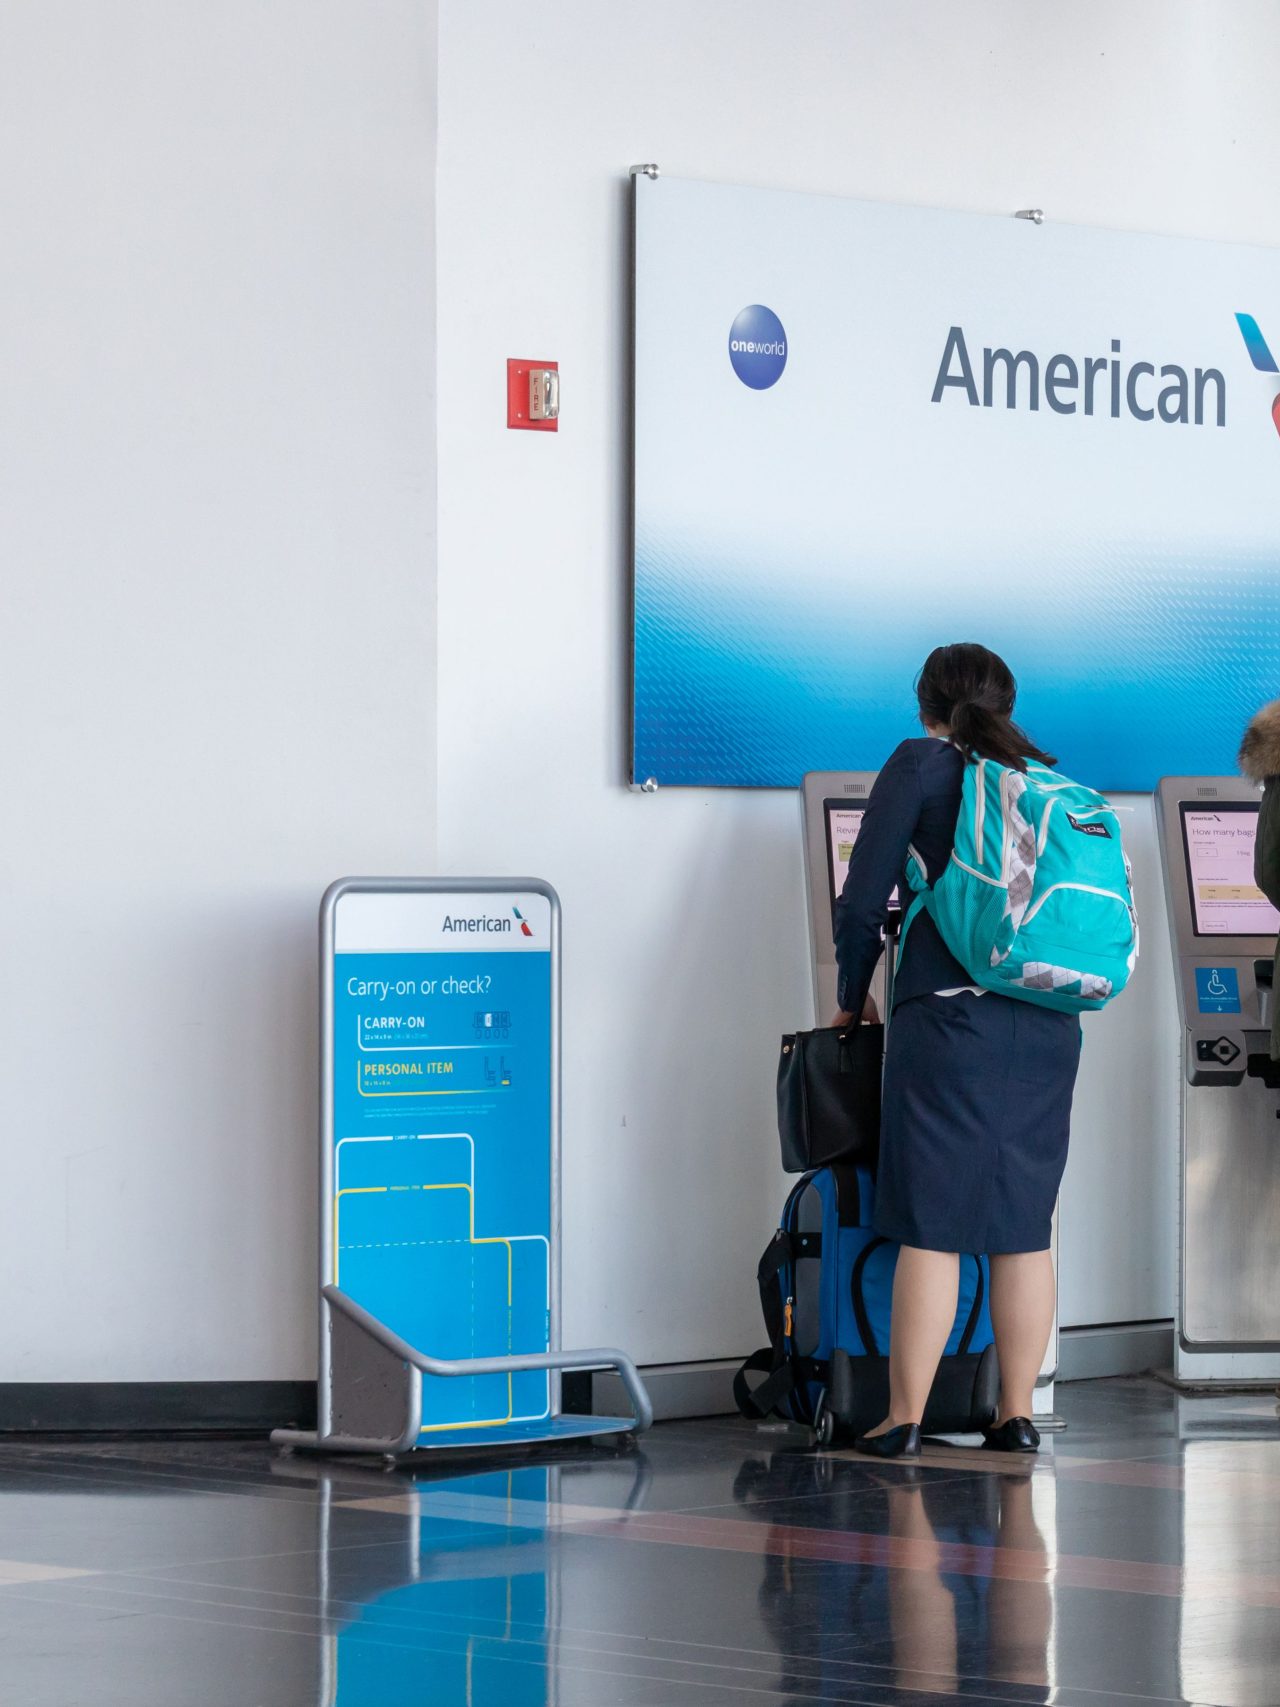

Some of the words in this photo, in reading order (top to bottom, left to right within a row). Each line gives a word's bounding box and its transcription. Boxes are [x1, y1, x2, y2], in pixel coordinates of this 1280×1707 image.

[731, 339, 785, 357] oneworld
[931, 326, 1226, 427] American
[1192, 828, 1211, 836] How
[1213, 829, 1235, 838] many
[442, 915, 511, 933] American
[347, 977, 416, 1001] Carry-on
[420, 980, 438, 995] or
[441, 975, 492, 995] check?
[364, 1016, 425, 1029] CARRY-ON
[364, 1062, 424, 1076] PERSONAL
[426, 1062, 454, 1074] ITEM
